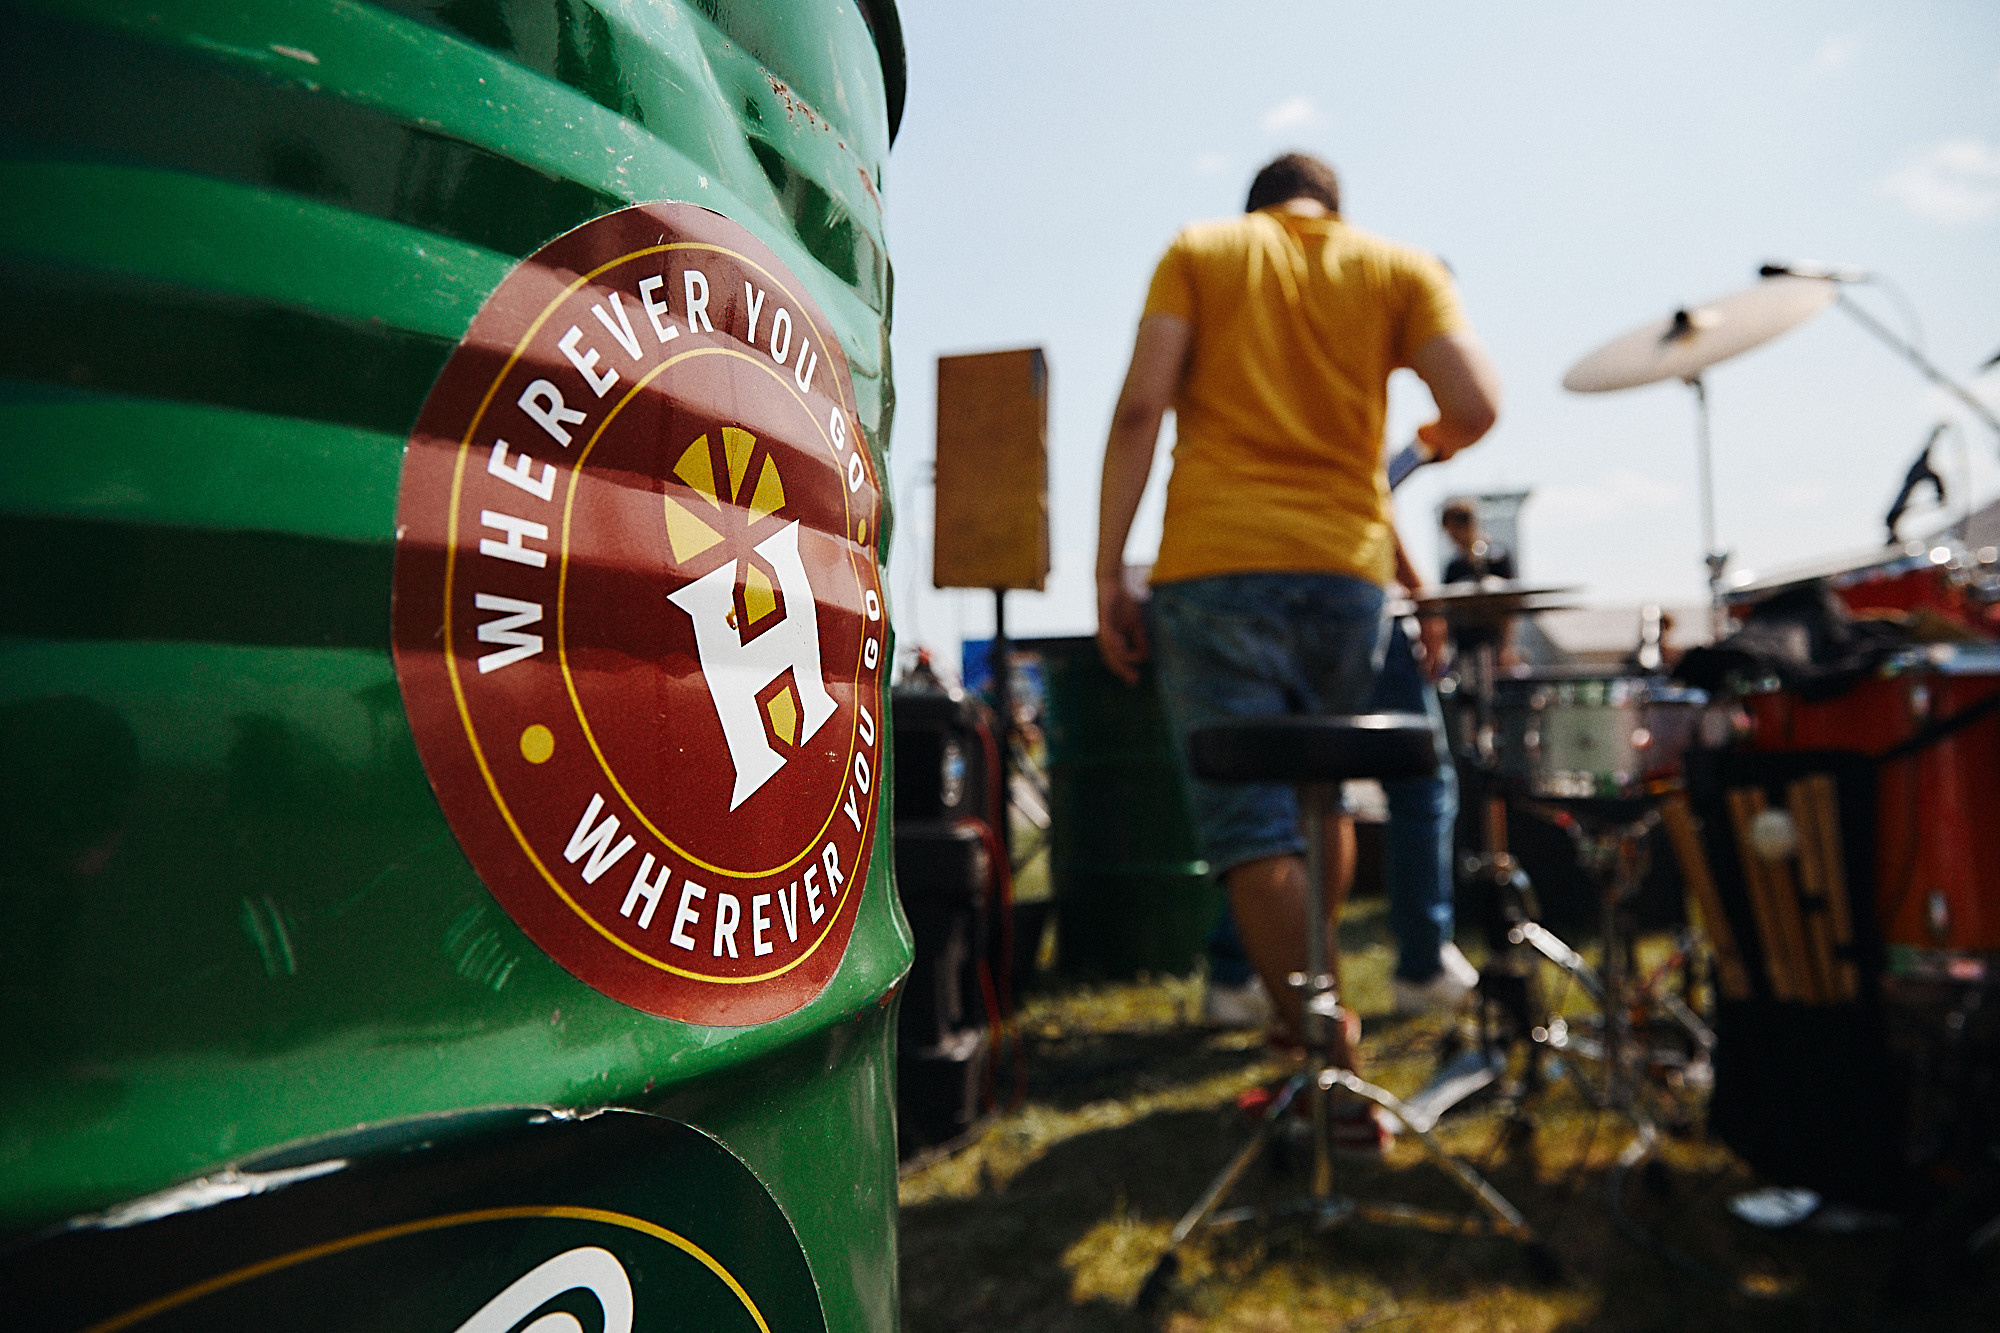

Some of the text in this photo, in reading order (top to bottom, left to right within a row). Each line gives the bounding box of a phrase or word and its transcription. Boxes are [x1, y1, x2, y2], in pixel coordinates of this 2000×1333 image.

[475, 270, 865, 674] WHEREVER YOU GO
[563, 589, 881, 958] WHEREVER YOU GO
